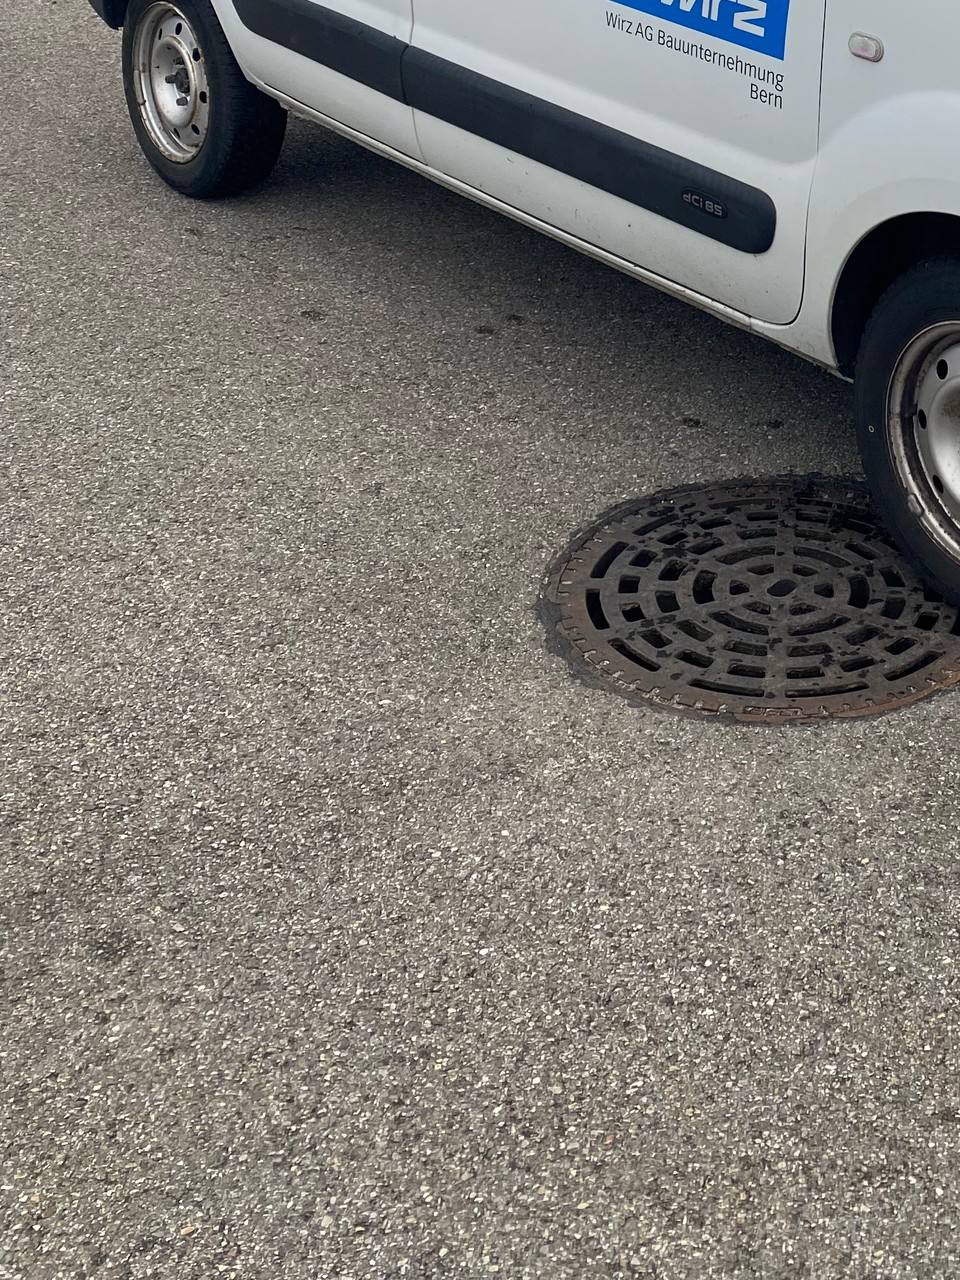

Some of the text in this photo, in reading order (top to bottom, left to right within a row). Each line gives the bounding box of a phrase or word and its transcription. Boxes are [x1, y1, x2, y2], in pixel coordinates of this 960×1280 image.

[605, 10, 785, 92] Wirz AG Bauunternehmung
[750, 83, 783, 109] Bern
[704, 200, 723, 216] 85
